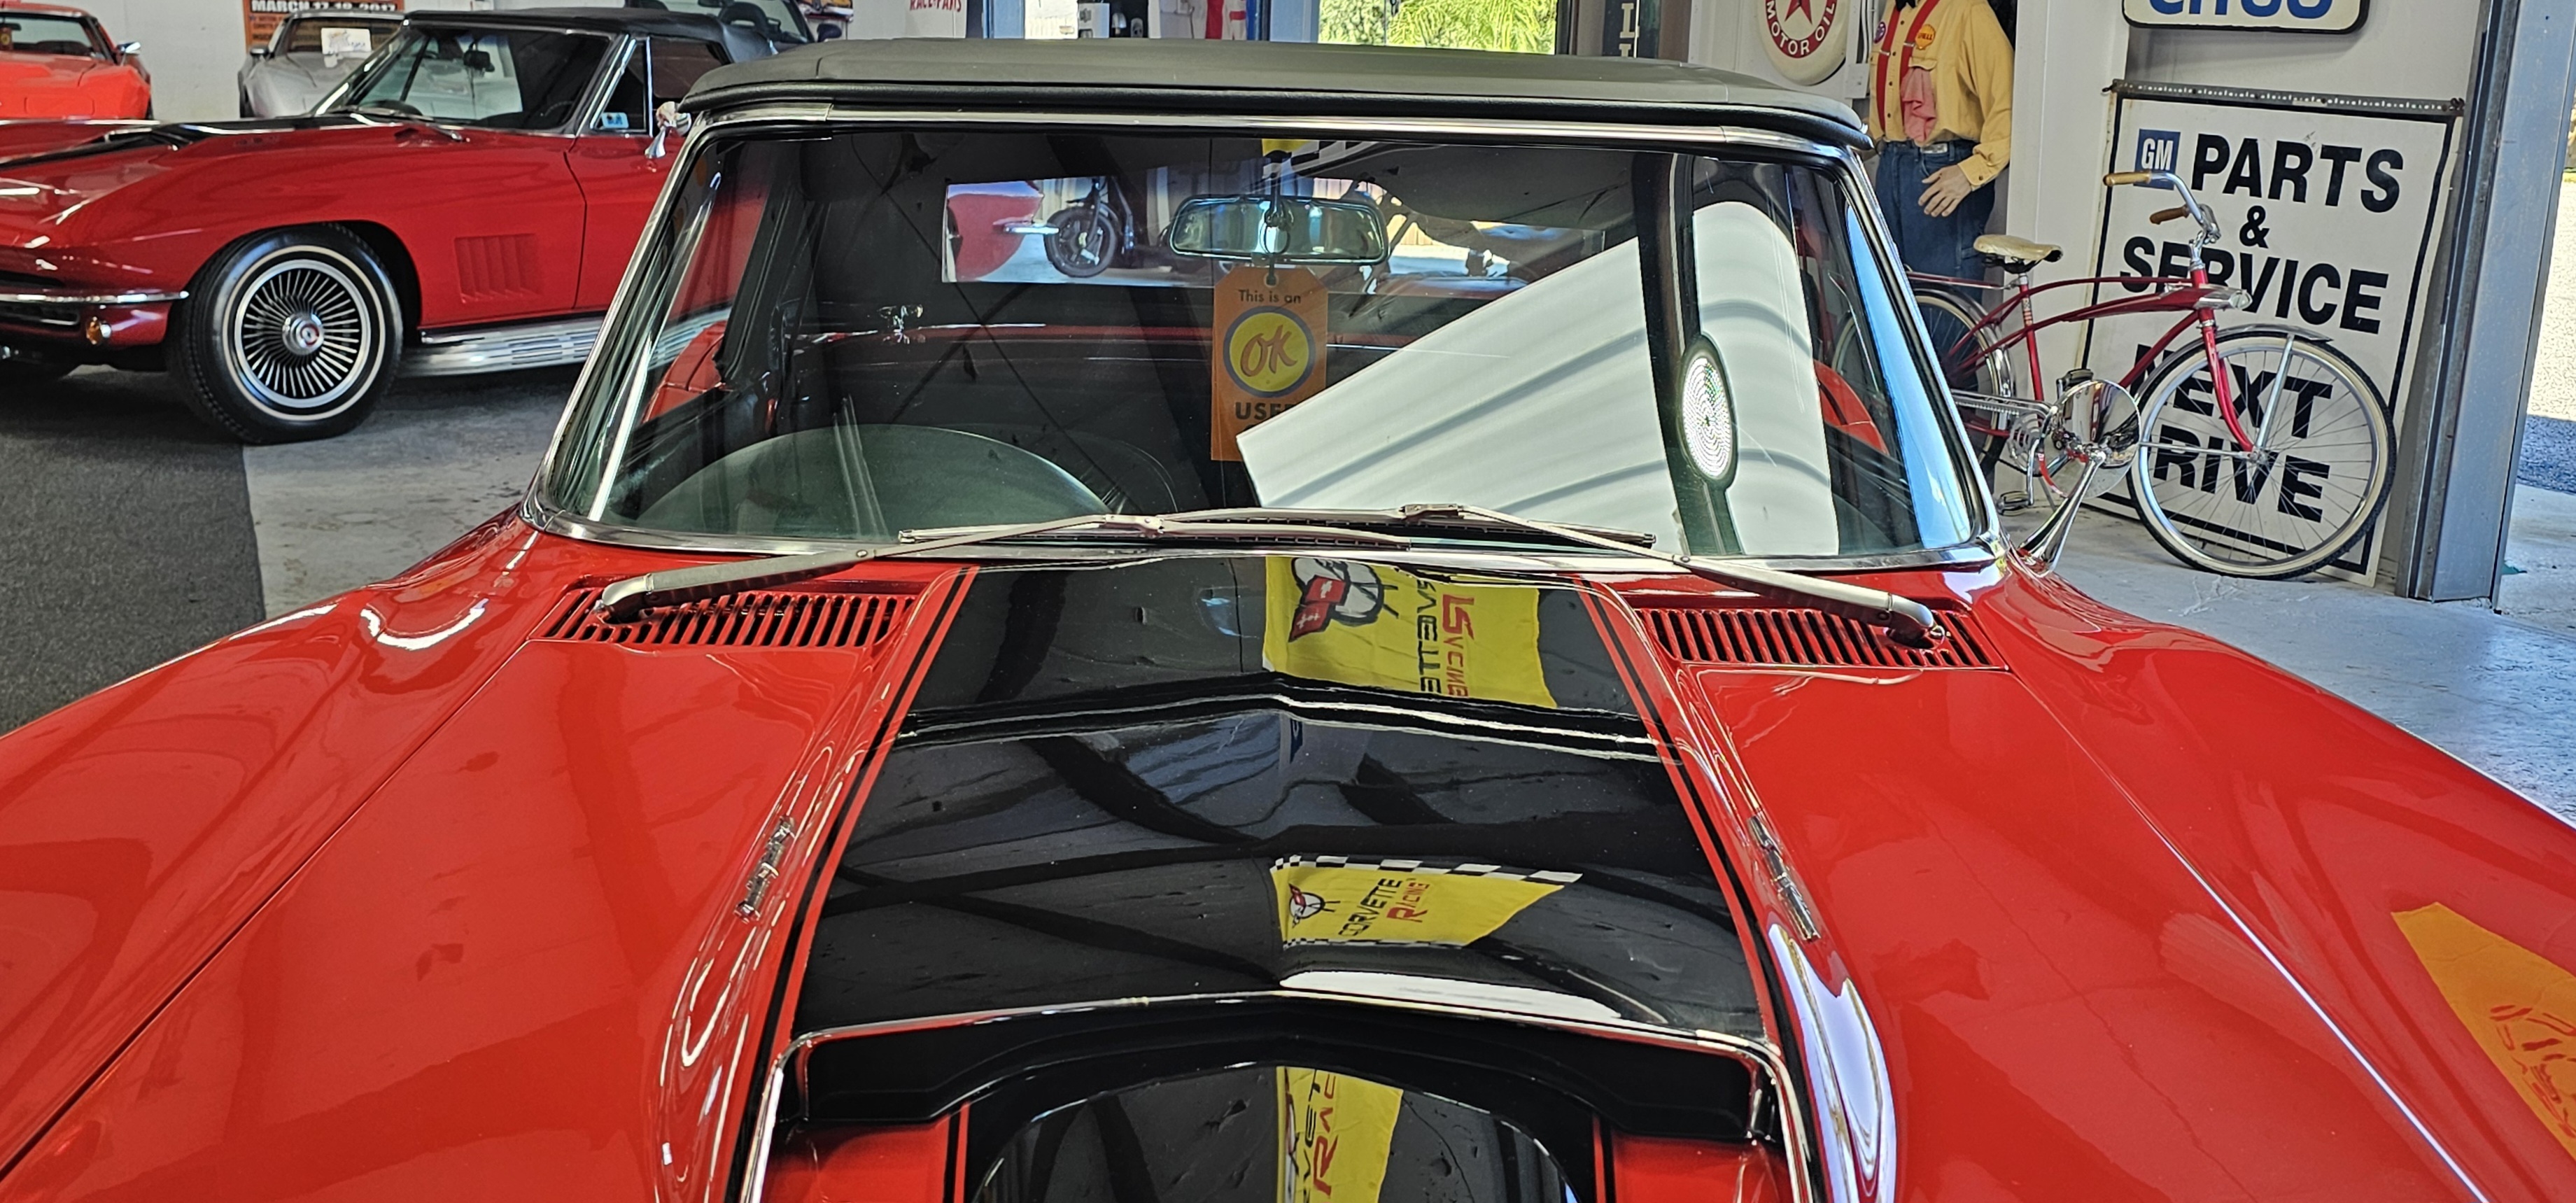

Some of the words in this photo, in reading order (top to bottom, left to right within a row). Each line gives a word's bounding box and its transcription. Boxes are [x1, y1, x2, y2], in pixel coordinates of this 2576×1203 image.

[251, 0, 310, 12] MARCH
[1766, 0, 1810, 55] MOTOR
[1815, 3, 1835, 41] OIL
[2141, 138, 2174, 171] GM
[2191, 133, 2403, 213] PARTS
[2239, 205, 2269, 248] &
[1238, 289, 1264, 302] This
[1269, 290, 1279, 303] is
[1284, 294, 1301, 304] an
[1240, 324, 1297, 377] OK
[1235, 402, 1295, 421] USE
[2147, 424, 2330, 523] RIVE
[1338, 878, 1402, 936] CORVETTE
